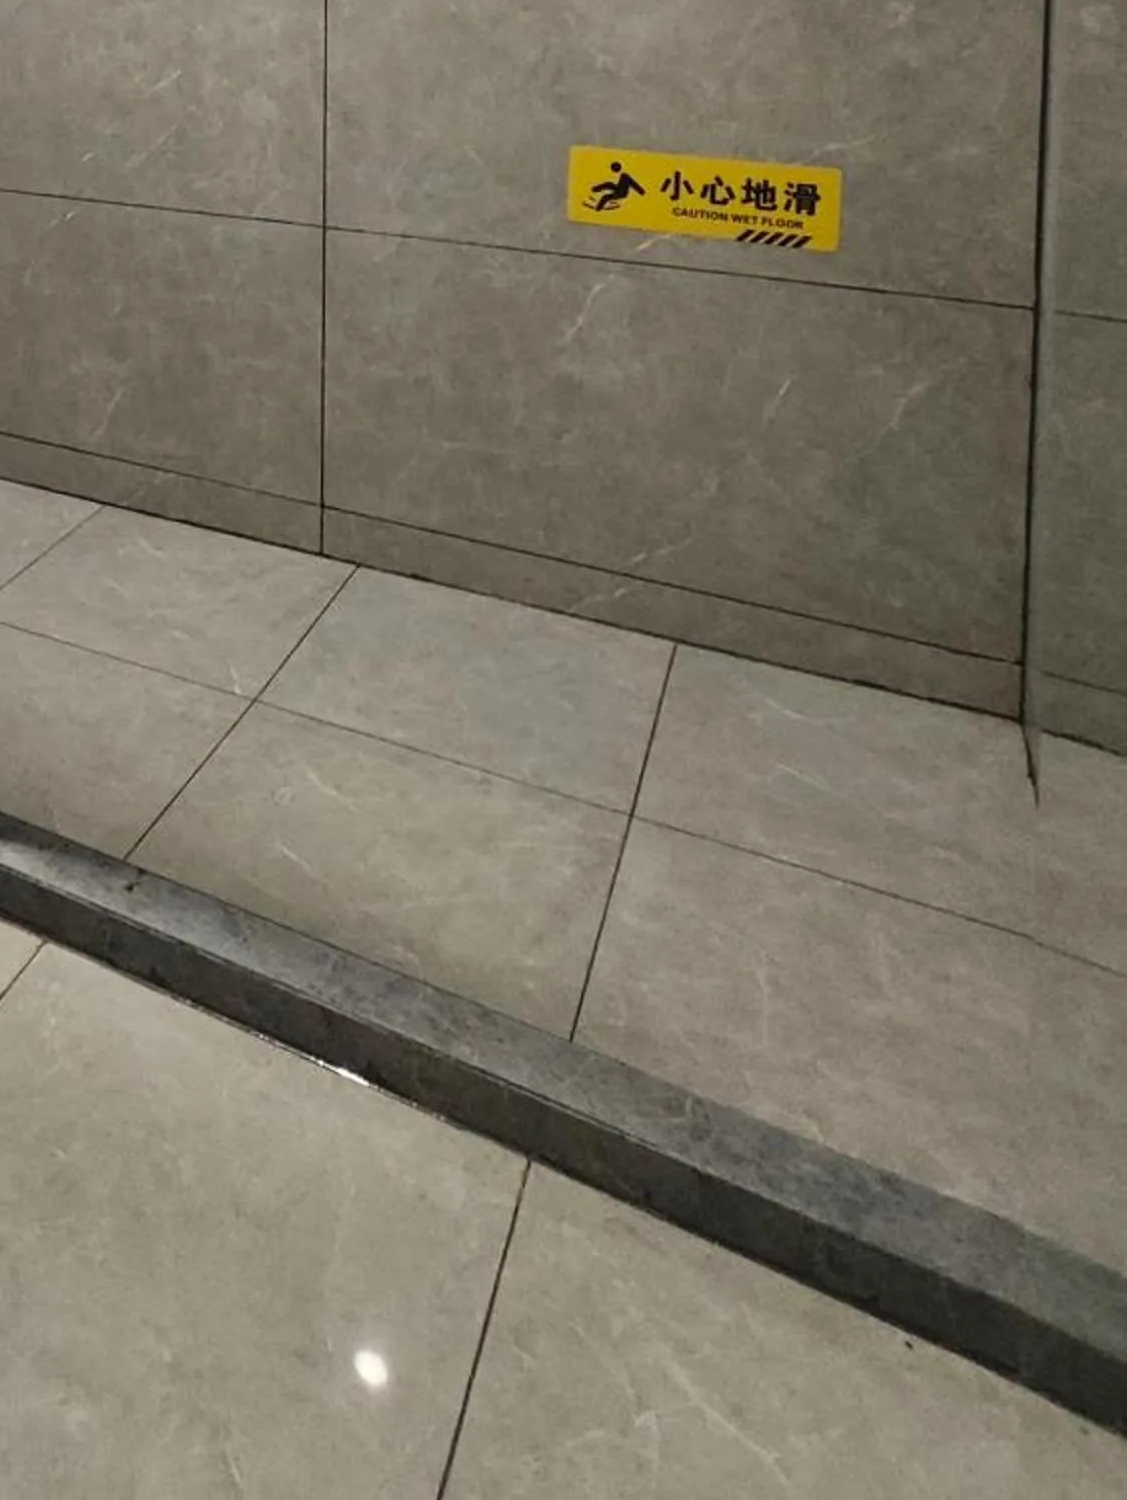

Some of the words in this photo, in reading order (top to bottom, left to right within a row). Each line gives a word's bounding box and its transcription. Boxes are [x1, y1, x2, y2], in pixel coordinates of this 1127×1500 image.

[660, 170, 821, 216] 小心地滑
[672, 206, 728, 221] CAUTION
[731, 213, 758, 225] WET
[761, 215, 804, 229] FLOOR
